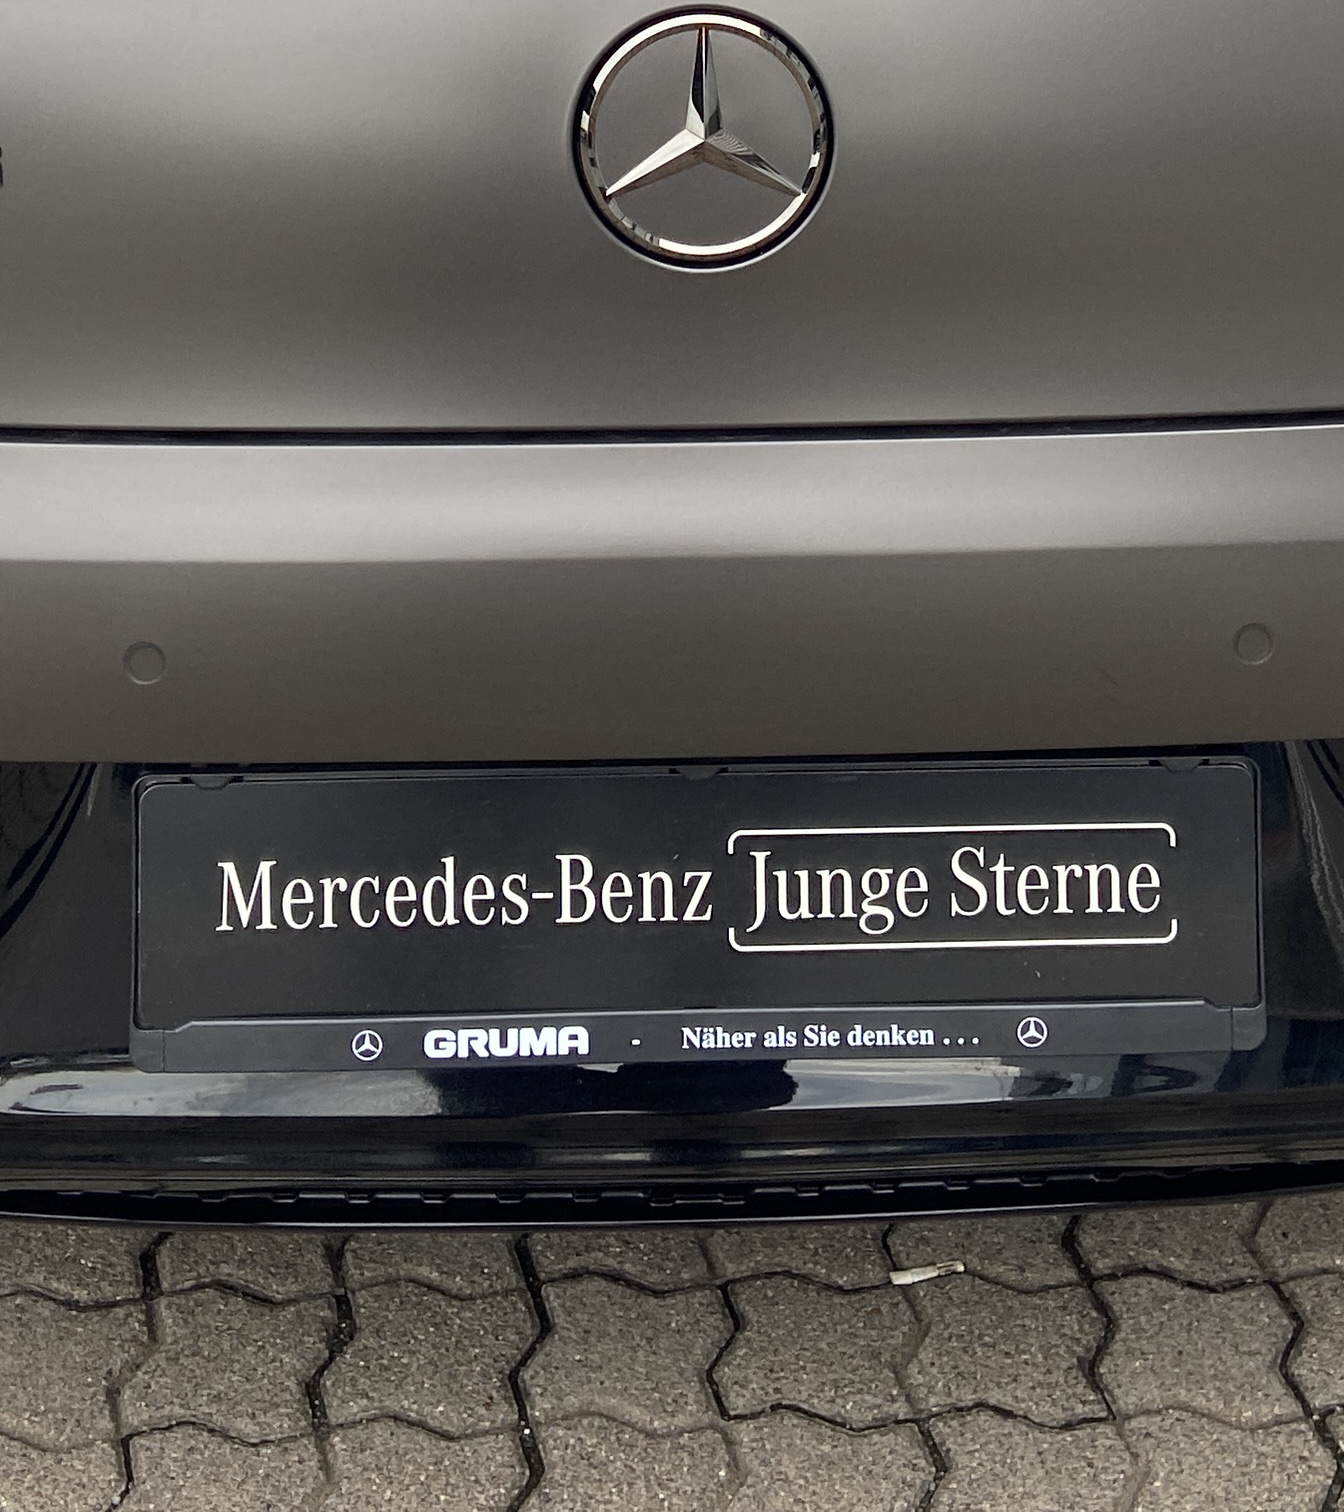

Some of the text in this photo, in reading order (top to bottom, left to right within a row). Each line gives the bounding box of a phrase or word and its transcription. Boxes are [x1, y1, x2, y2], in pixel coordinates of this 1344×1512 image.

[214, 846, 1161, 935] Mercedes-Benz Junge Sterne
[422, 1025, 590, 1059] GRUMA
[680, 1026, 757, 1050] Näher
[762, 1025, 797, 1049] als
[802, 1024, 841, 1048] Sie
[846, 1023, 936, 1048] denken
